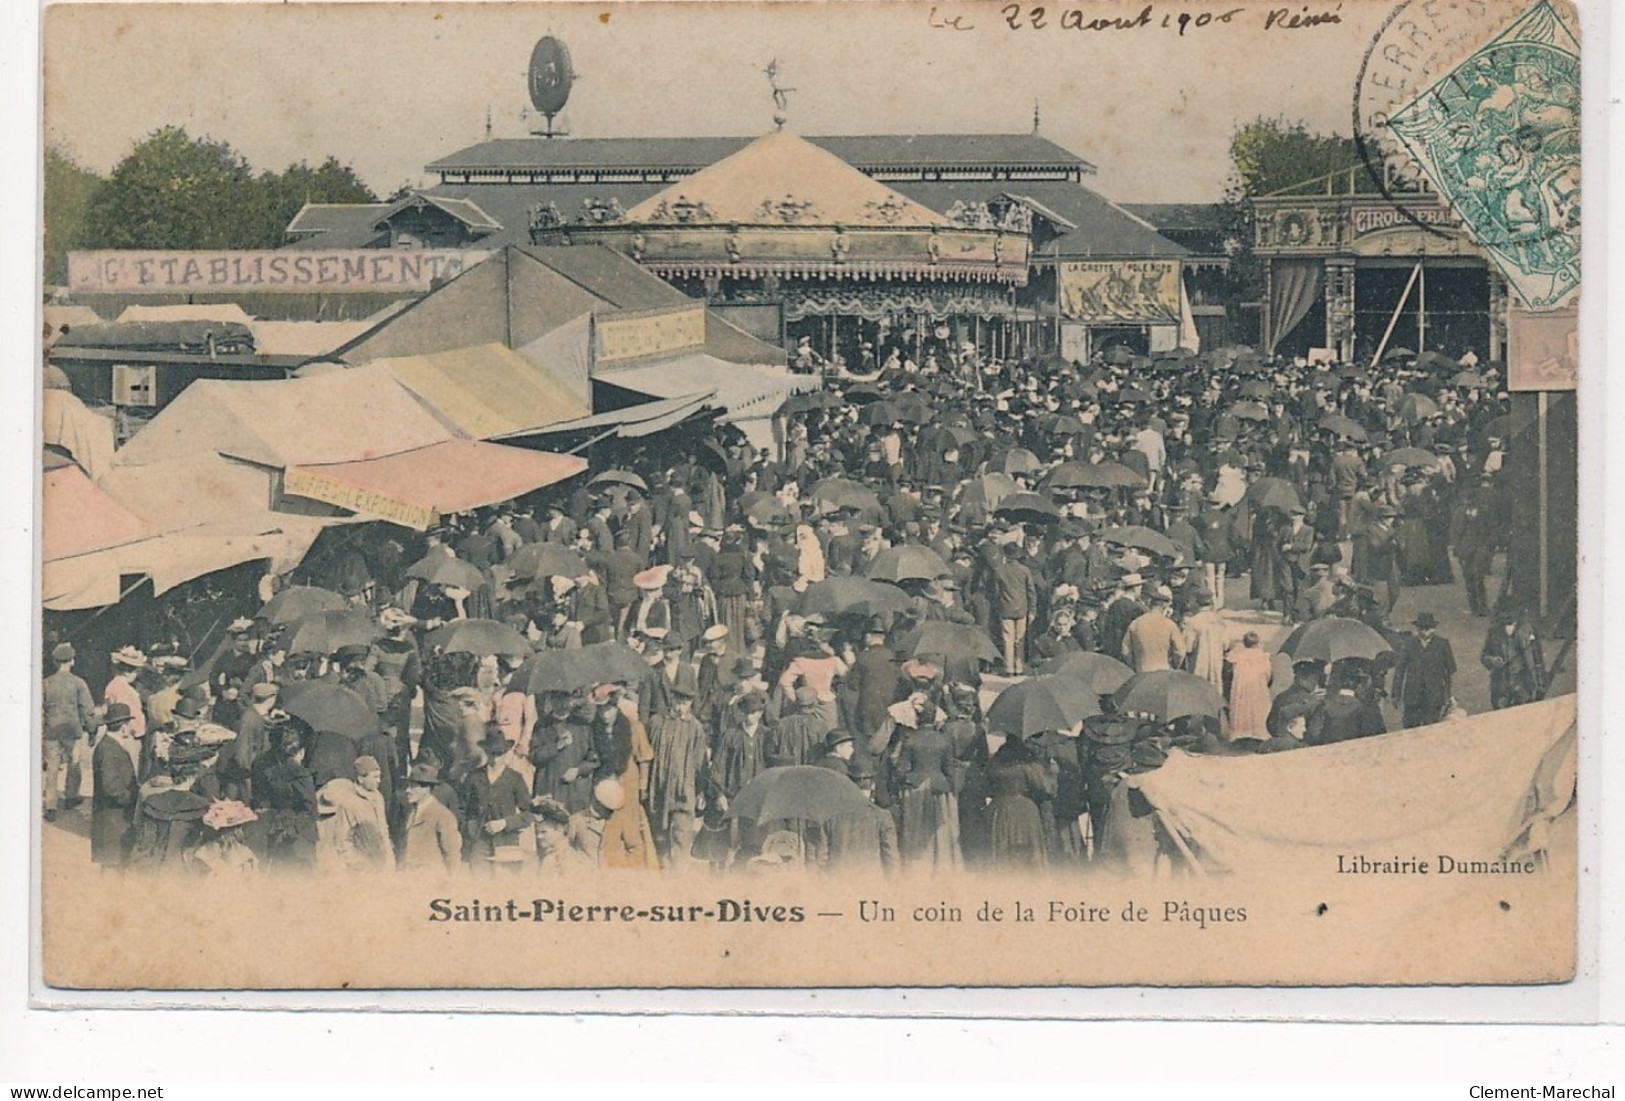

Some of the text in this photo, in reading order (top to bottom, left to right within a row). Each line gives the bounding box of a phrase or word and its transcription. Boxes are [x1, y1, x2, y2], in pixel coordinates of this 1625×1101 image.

[1001, 3, 1048, 30] 22
[1337, 855, 1535, 875] Librairie Dumaine
[428, 898, 1248, 929] Saint-Pierre-sur-Dives Un coin de la Foire de Pâques
